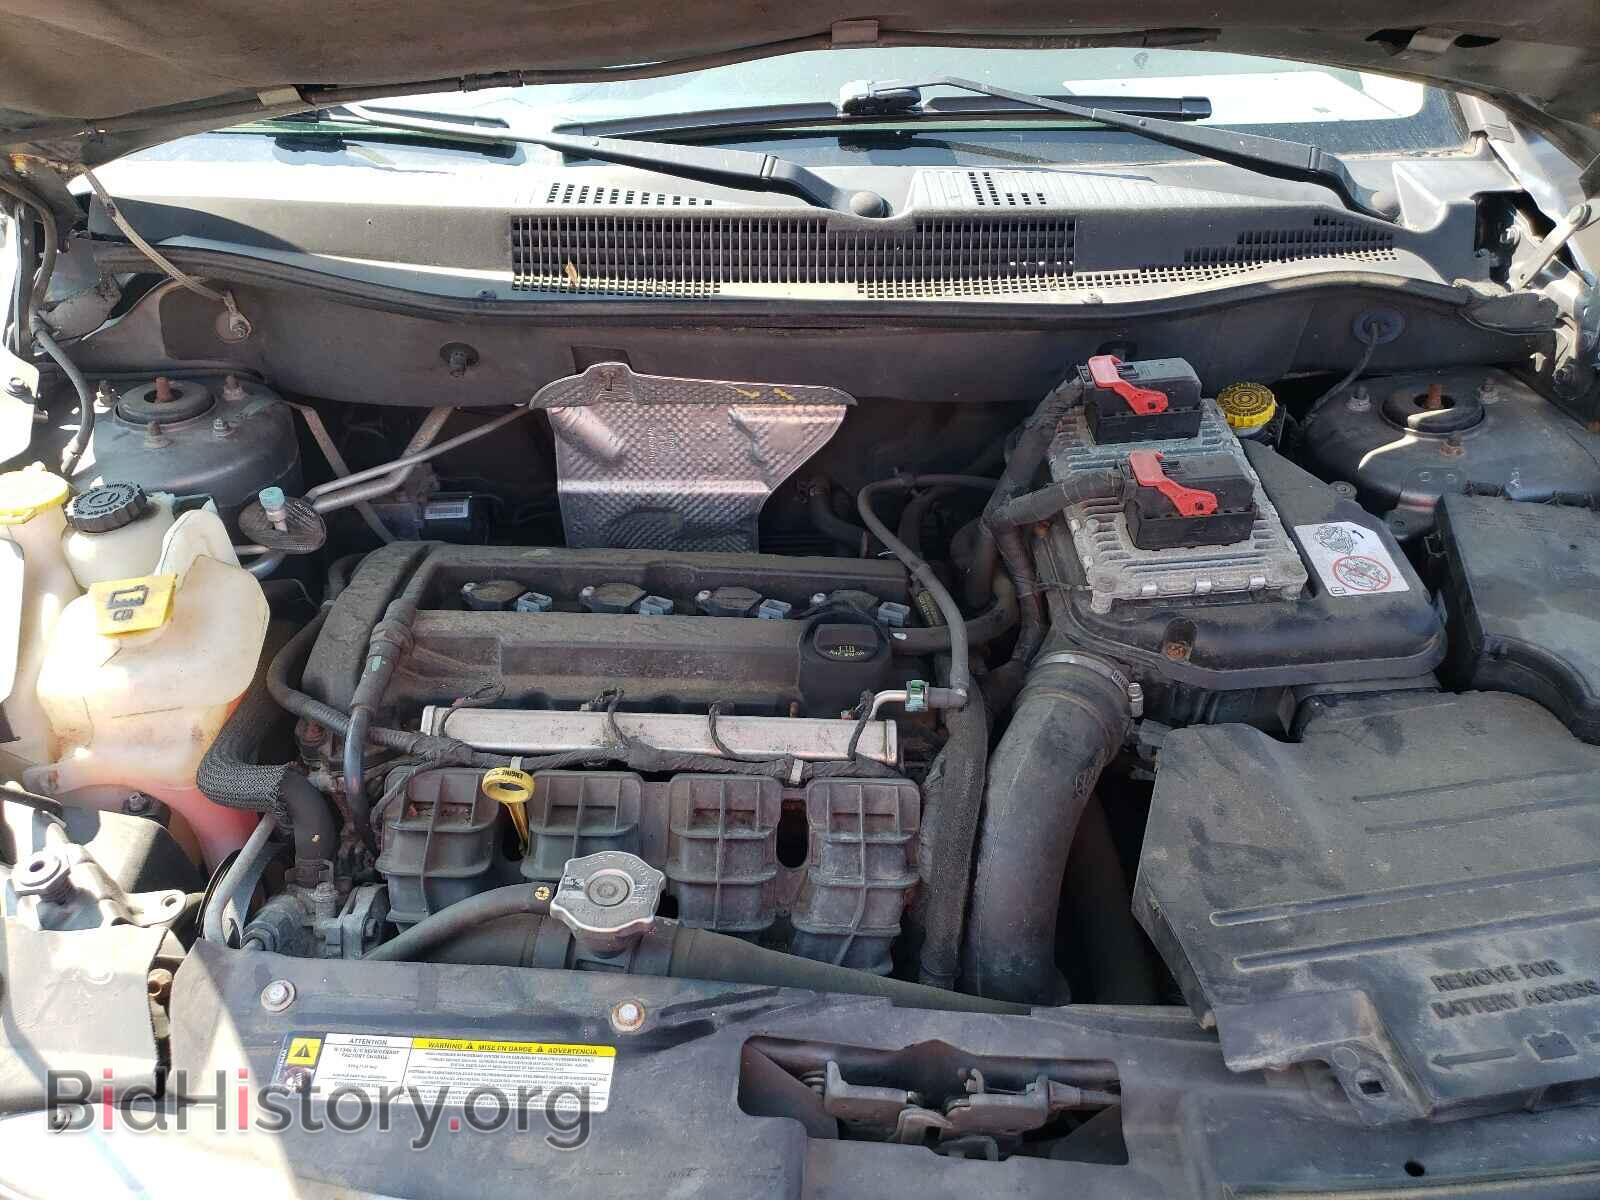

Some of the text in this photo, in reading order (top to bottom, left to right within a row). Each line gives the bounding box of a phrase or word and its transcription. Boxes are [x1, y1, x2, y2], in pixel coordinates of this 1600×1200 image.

[501, 769, 523, 779] ENGINE
[1430, 959, 1566, 992] REMOVE FOR
[1431, 992, 1519, 1020] BATTERY
[349, 1038, 388, 1046] ATTENTION
[428, 1041, 463, 1050] WARNING
[547, 1047, 598, 1056] ADVERTENCIA
